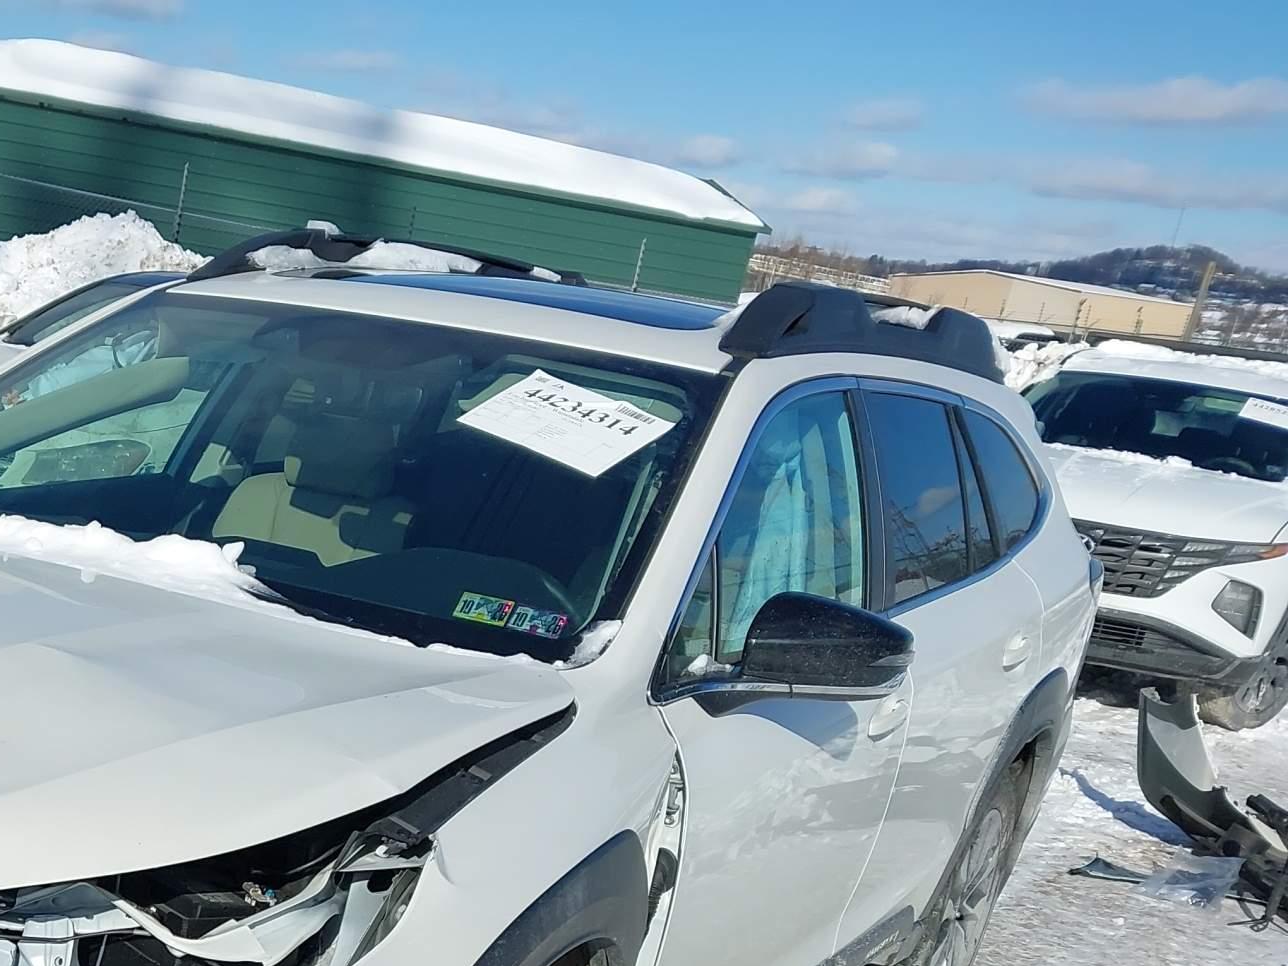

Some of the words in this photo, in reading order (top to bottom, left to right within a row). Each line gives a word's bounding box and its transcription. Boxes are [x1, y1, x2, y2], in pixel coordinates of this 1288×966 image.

[523, 388, 640, 436] 44234314
[460, 599, 475, 615] 10
[512, 611, 528, 627] 10
